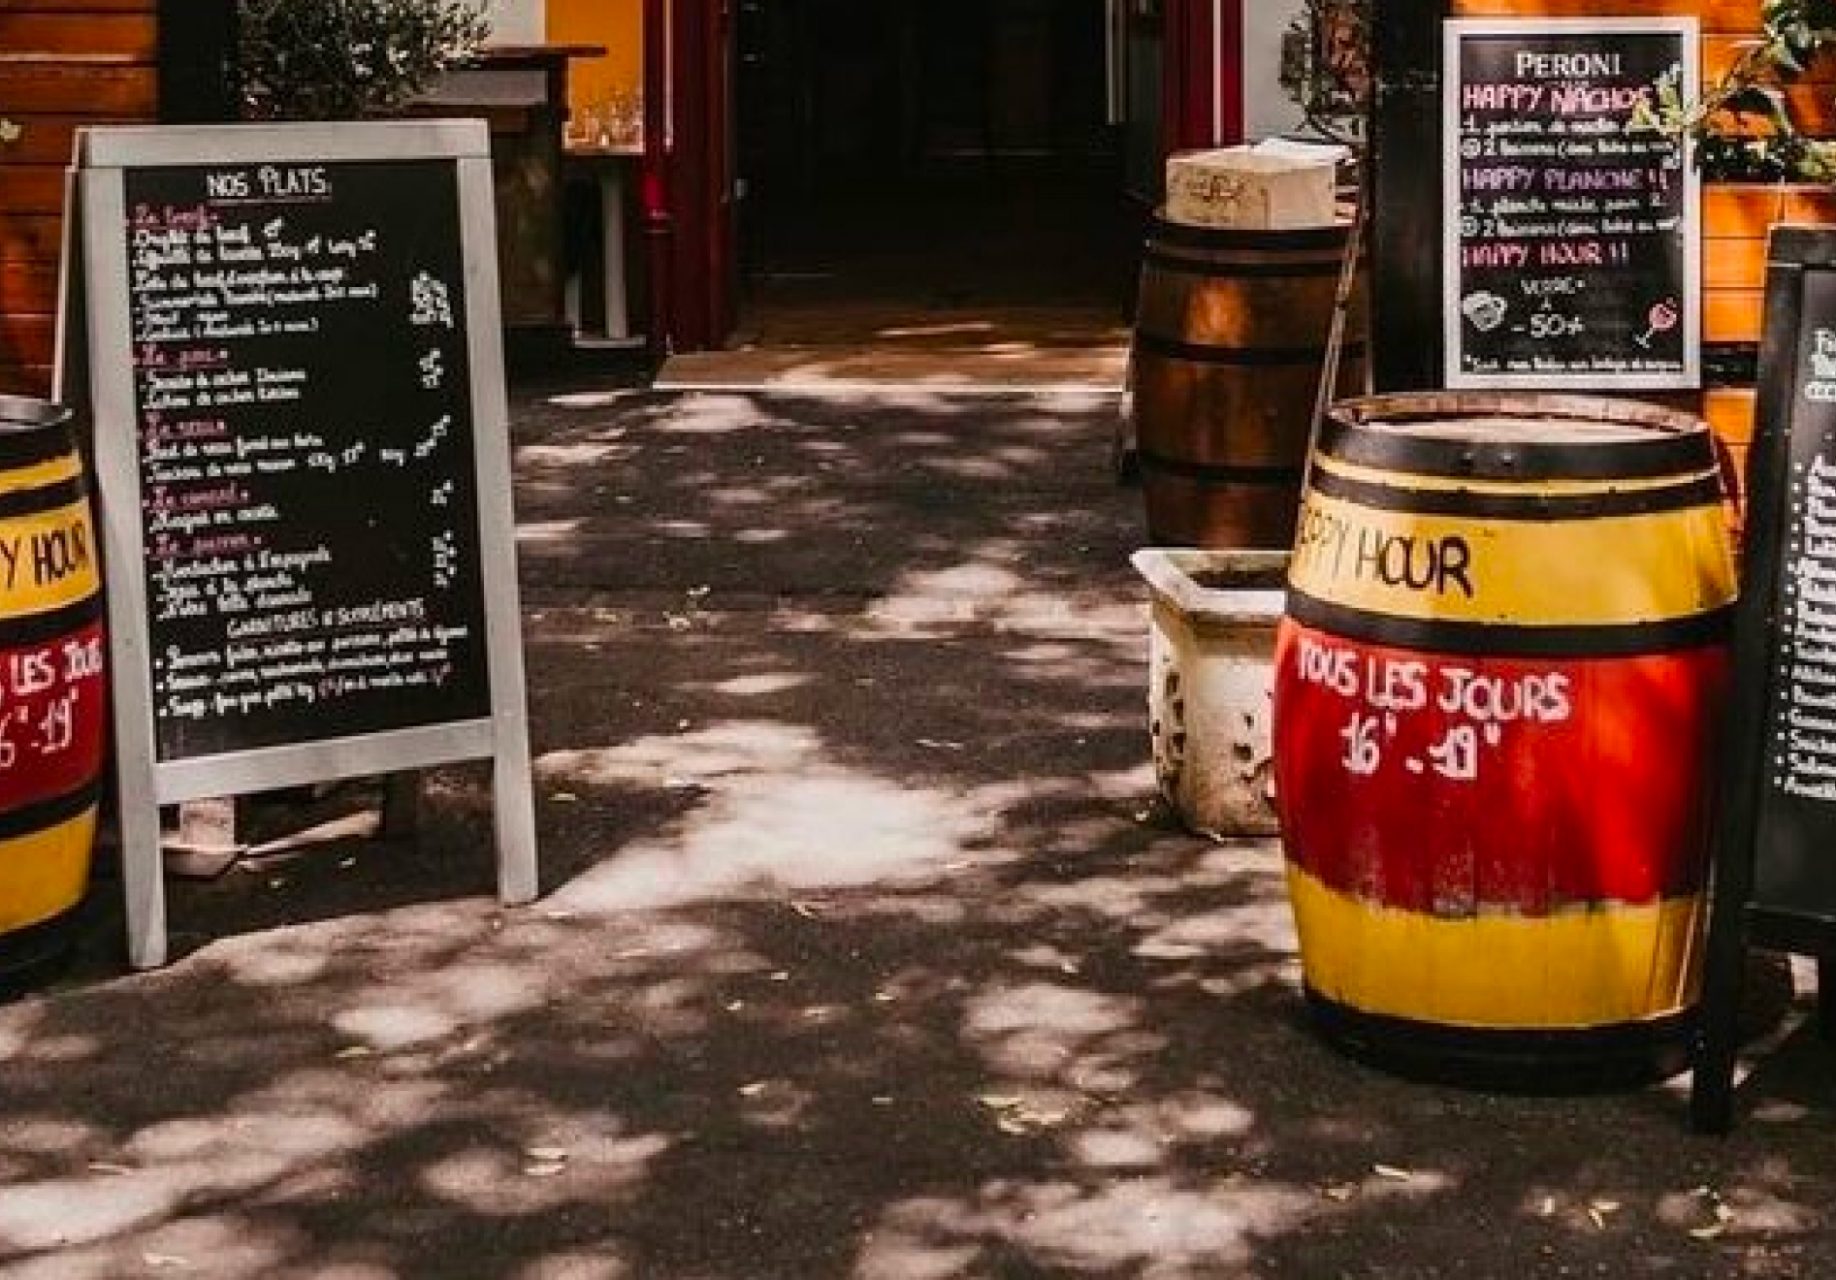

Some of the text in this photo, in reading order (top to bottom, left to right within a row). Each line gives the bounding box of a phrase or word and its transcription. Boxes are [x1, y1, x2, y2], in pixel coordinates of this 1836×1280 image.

[1516, 51, 1622, 77] PERONI
[1463, 84, 1542, 111] HAPPY
[207, 172, 248, 197] NOS
[1463, 166, 1536, 191] HAPPY
[1462, 243, 1528, 268] HAPPY
[1540, 242, 1603, 265] HOUR
[1355, 527, 1475, 599] HOUR
[10, 649, 56, 697] LES
[1298, 637, 1573, 722] TOUS LES JOURS
